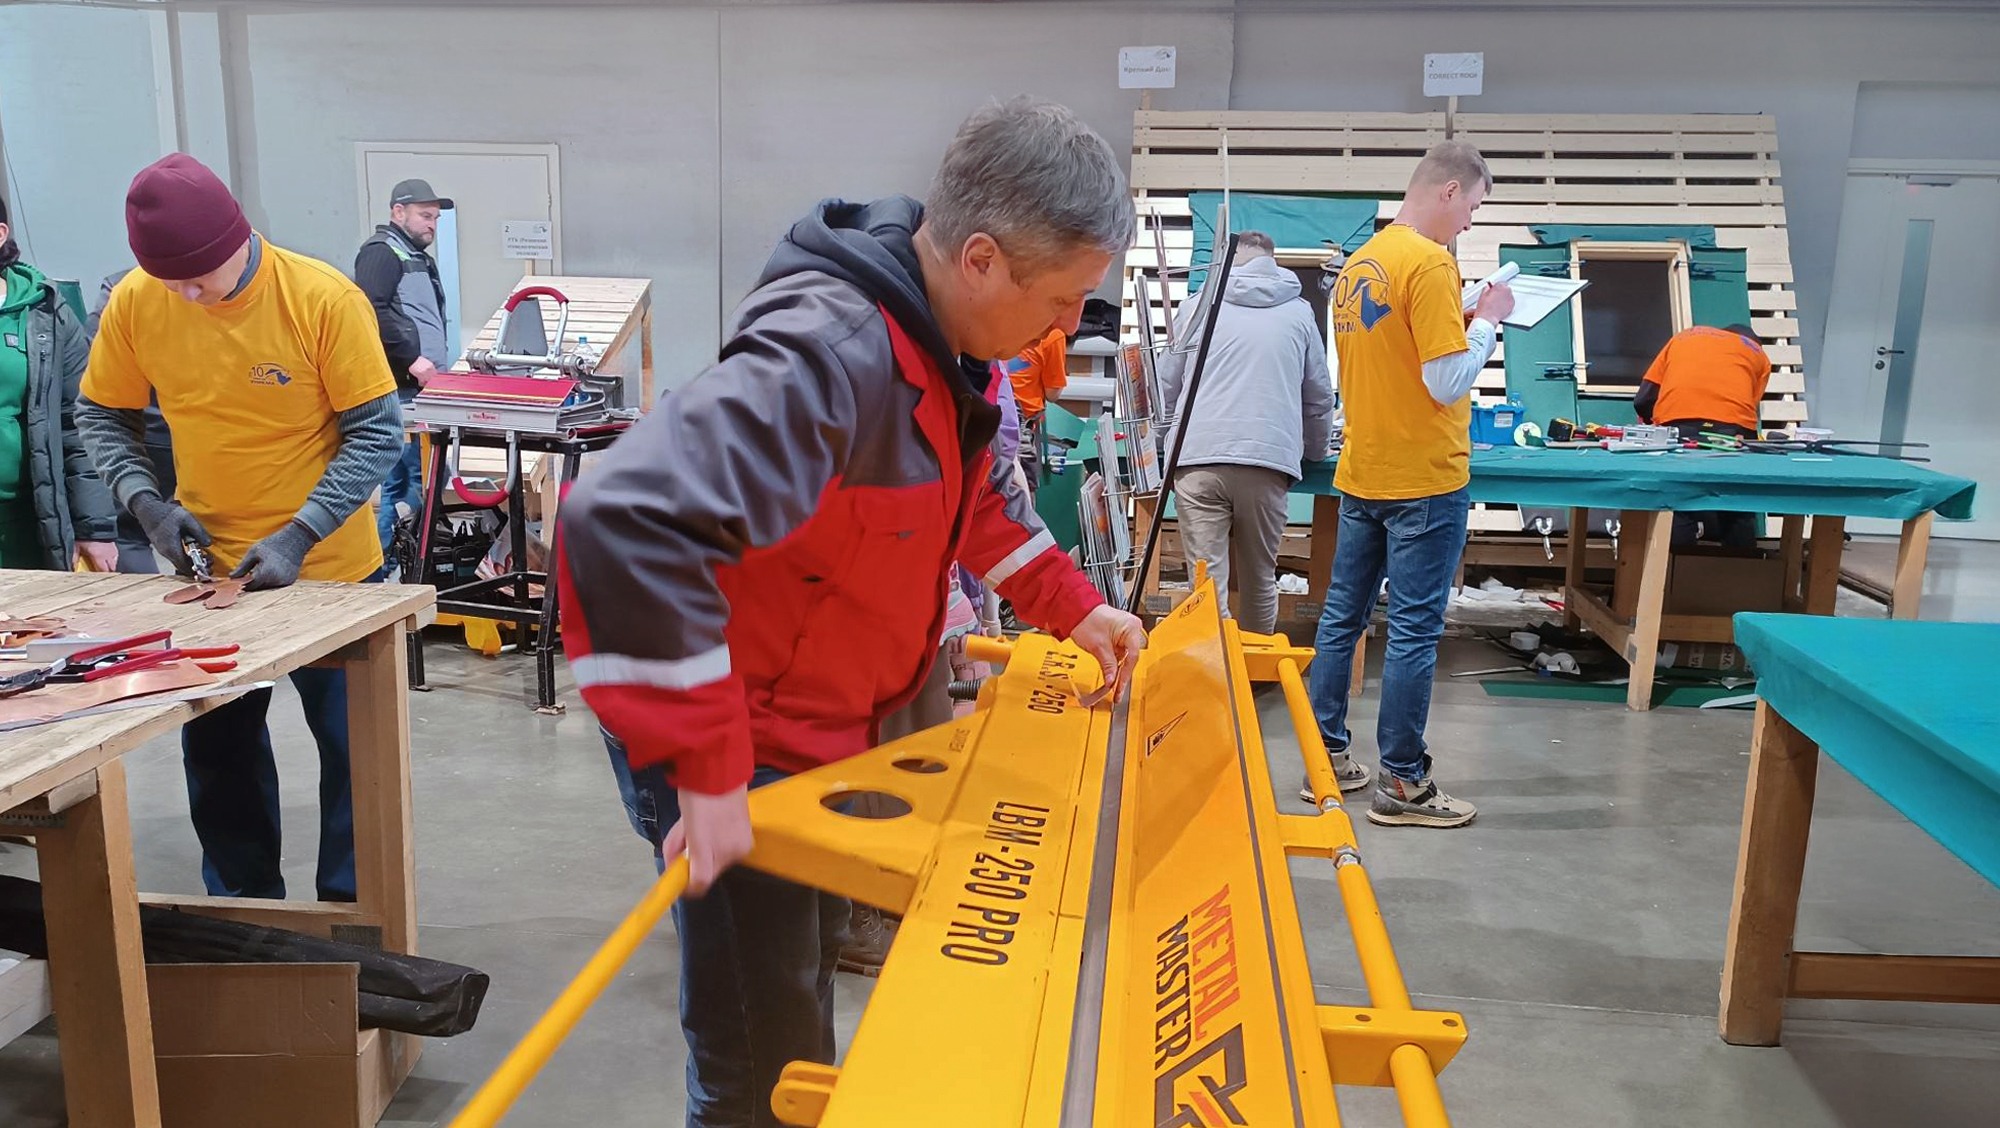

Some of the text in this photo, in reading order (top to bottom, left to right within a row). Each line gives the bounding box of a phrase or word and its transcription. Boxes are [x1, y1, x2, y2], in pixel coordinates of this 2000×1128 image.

[252, 366, 264, 377] 10
[940, 903, 1020, 966] PRO
[1191, 883, 1241, 1041] METAL
[1155, 913, 1192, 1071] MASTER
